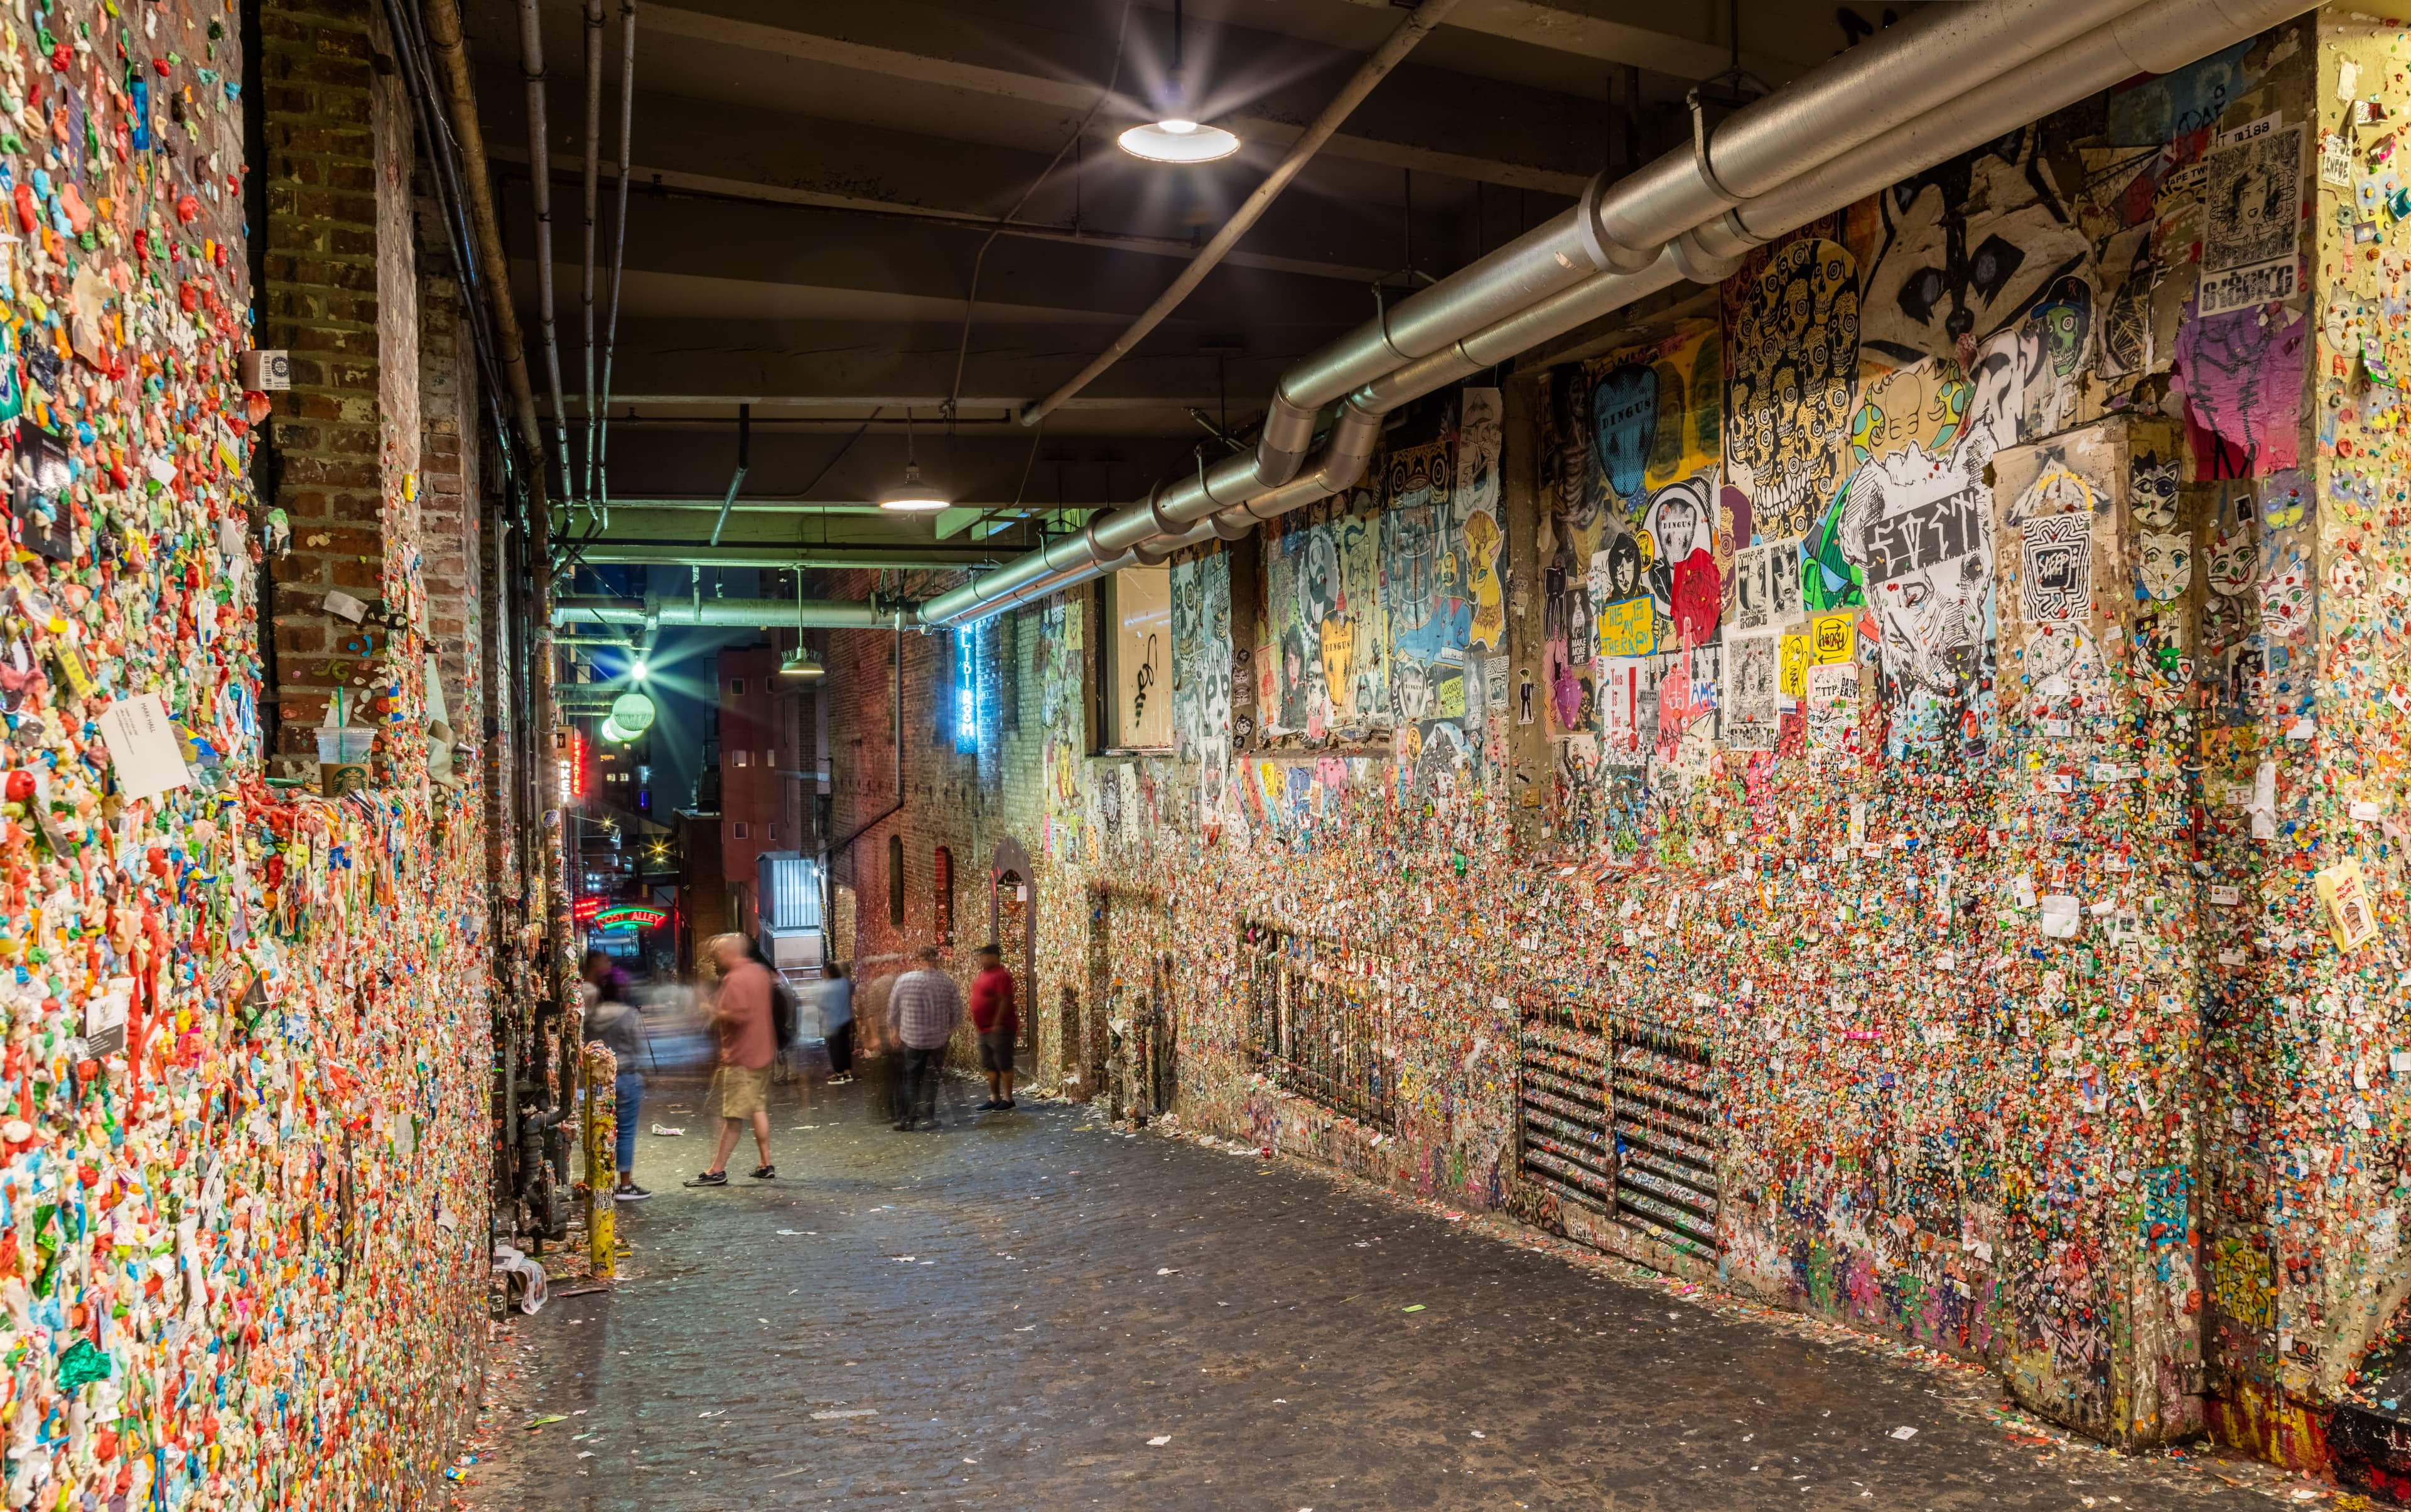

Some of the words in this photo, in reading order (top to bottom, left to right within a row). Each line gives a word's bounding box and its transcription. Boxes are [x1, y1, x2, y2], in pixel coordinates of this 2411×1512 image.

[2235, 121, 2270, 142] miss
[1602, 397, 1651, 431] DINGUS
[1663, 520, 1692, 529] DINGUS
[1602, 607, 1623, 627] THIS
[1633, 601, 1644, 622] IS
[1325, 639, 1351, 652] DINGUS
[1572, 638, 1587, 648] MAKE
[1572, 646, 1587, 656] MORE
[1602, 630, 1649, 655] THERAPY
[1862, 635, 1879, 648] DINGU
[961, 623, 972, 688] ALIBI
[140, 703, 149, 719] MARK
[148, 718, 156, 733] HALL
[962, 691, 974, 736] ROOM
[596, 912, 624, 930] POST
[630, 911, 664, 927] ALLEY
